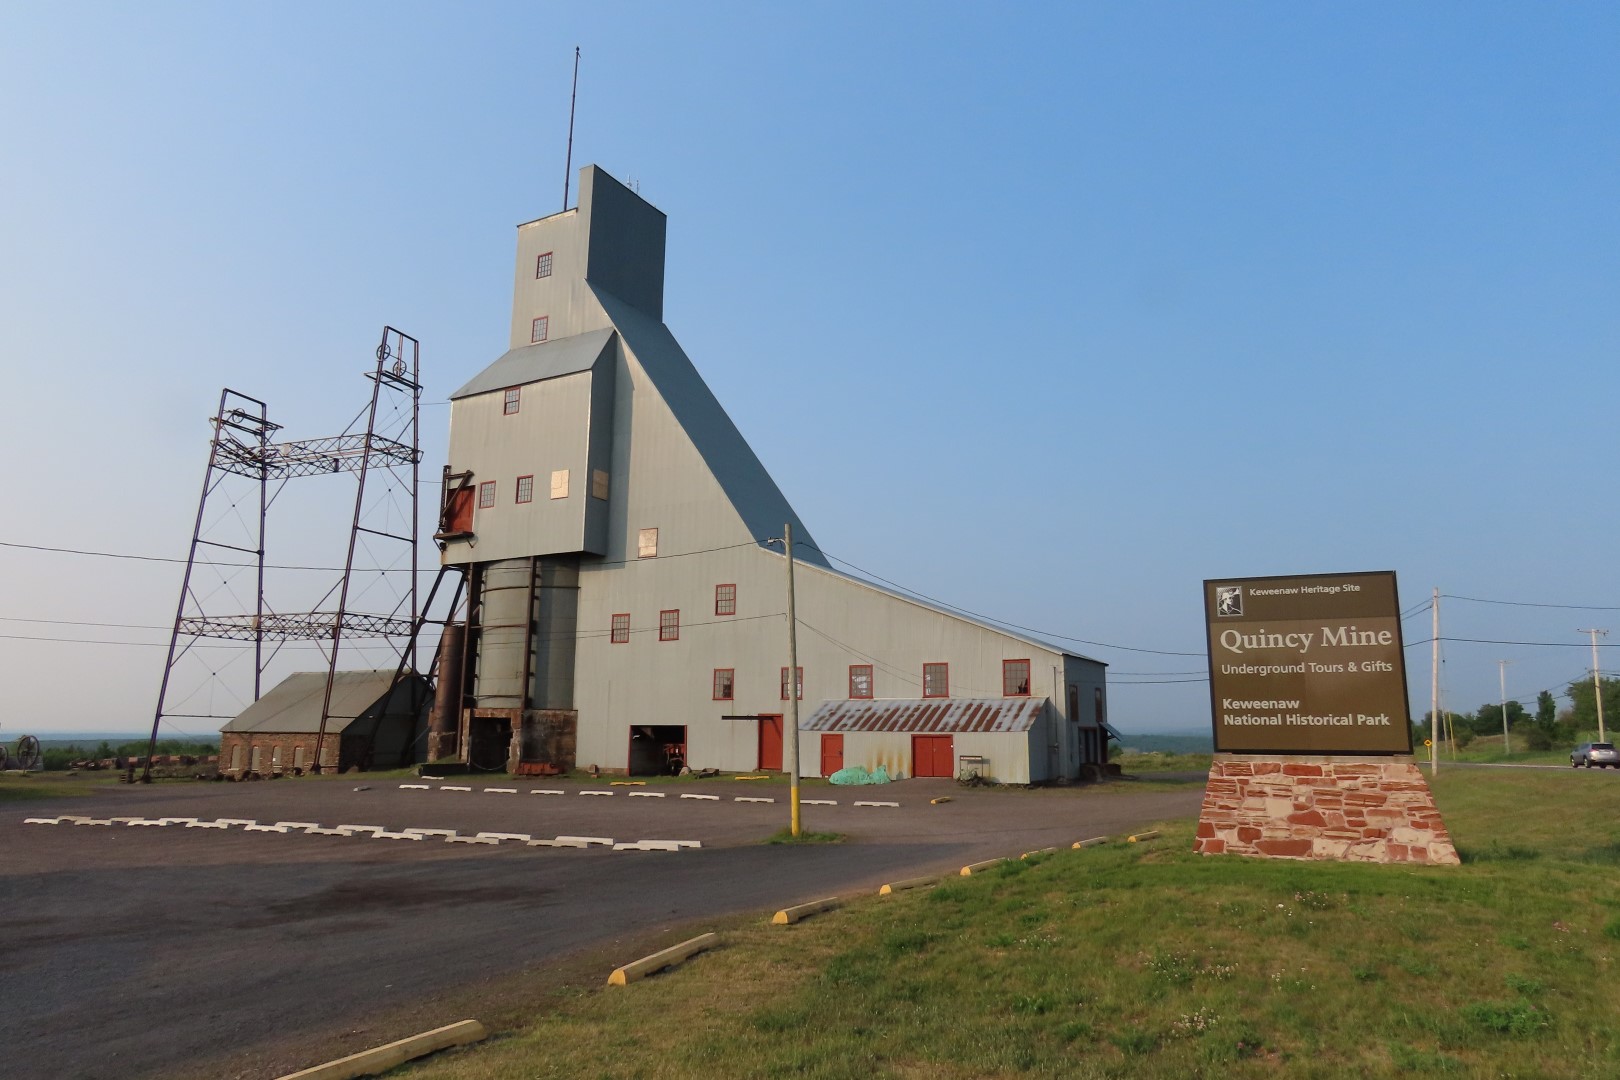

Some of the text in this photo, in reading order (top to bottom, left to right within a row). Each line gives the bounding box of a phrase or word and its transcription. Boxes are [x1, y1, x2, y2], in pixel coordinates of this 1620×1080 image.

[1250, 584, 1360, 596] Keweenaw Heritage Site
[1220, 626, 1392, 653] Quincy Mine
[1222, 661, 1392, 676] Underground Tours & Gifts
[1223, 699, 1300, 709] Keweenaw
[1224, 714, 1390, 726] National Historical Park
